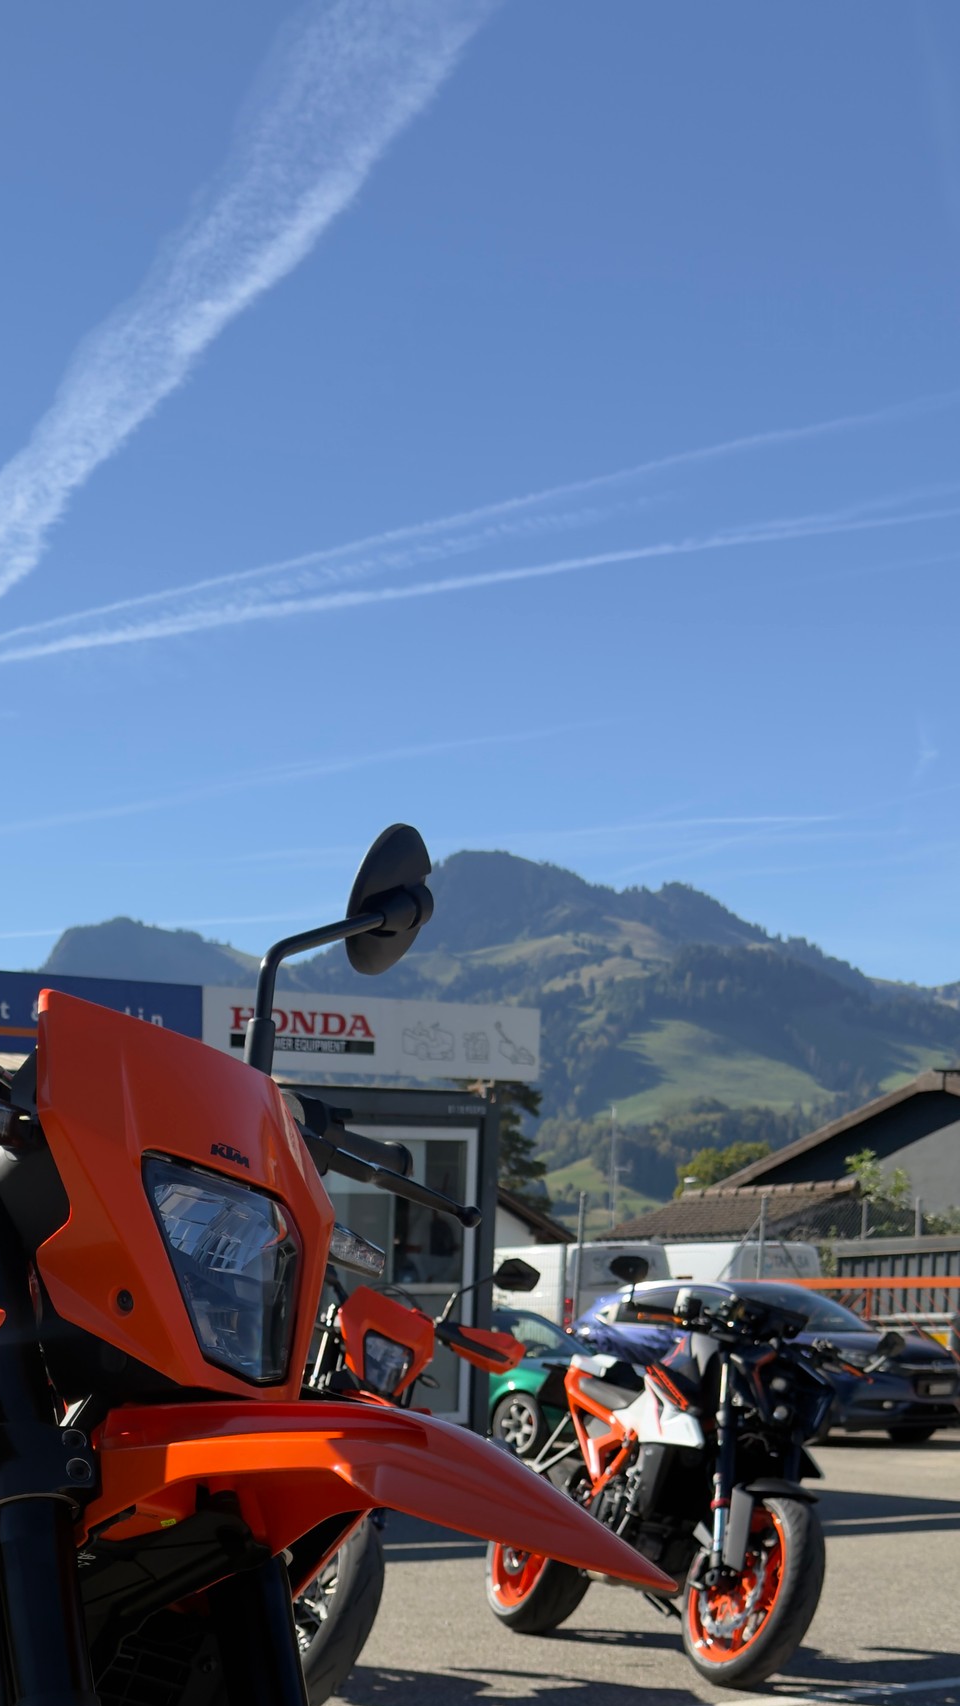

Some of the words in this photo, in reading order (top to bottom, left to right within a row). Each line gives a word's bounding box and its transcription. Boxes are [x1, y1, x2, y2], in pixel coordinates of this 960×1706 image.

[230, 1006, 375, 1038] HONDA
[294, 1038, 347, 1053] EQUIPMENT
[210, 1142, 250, 1169] KTM
